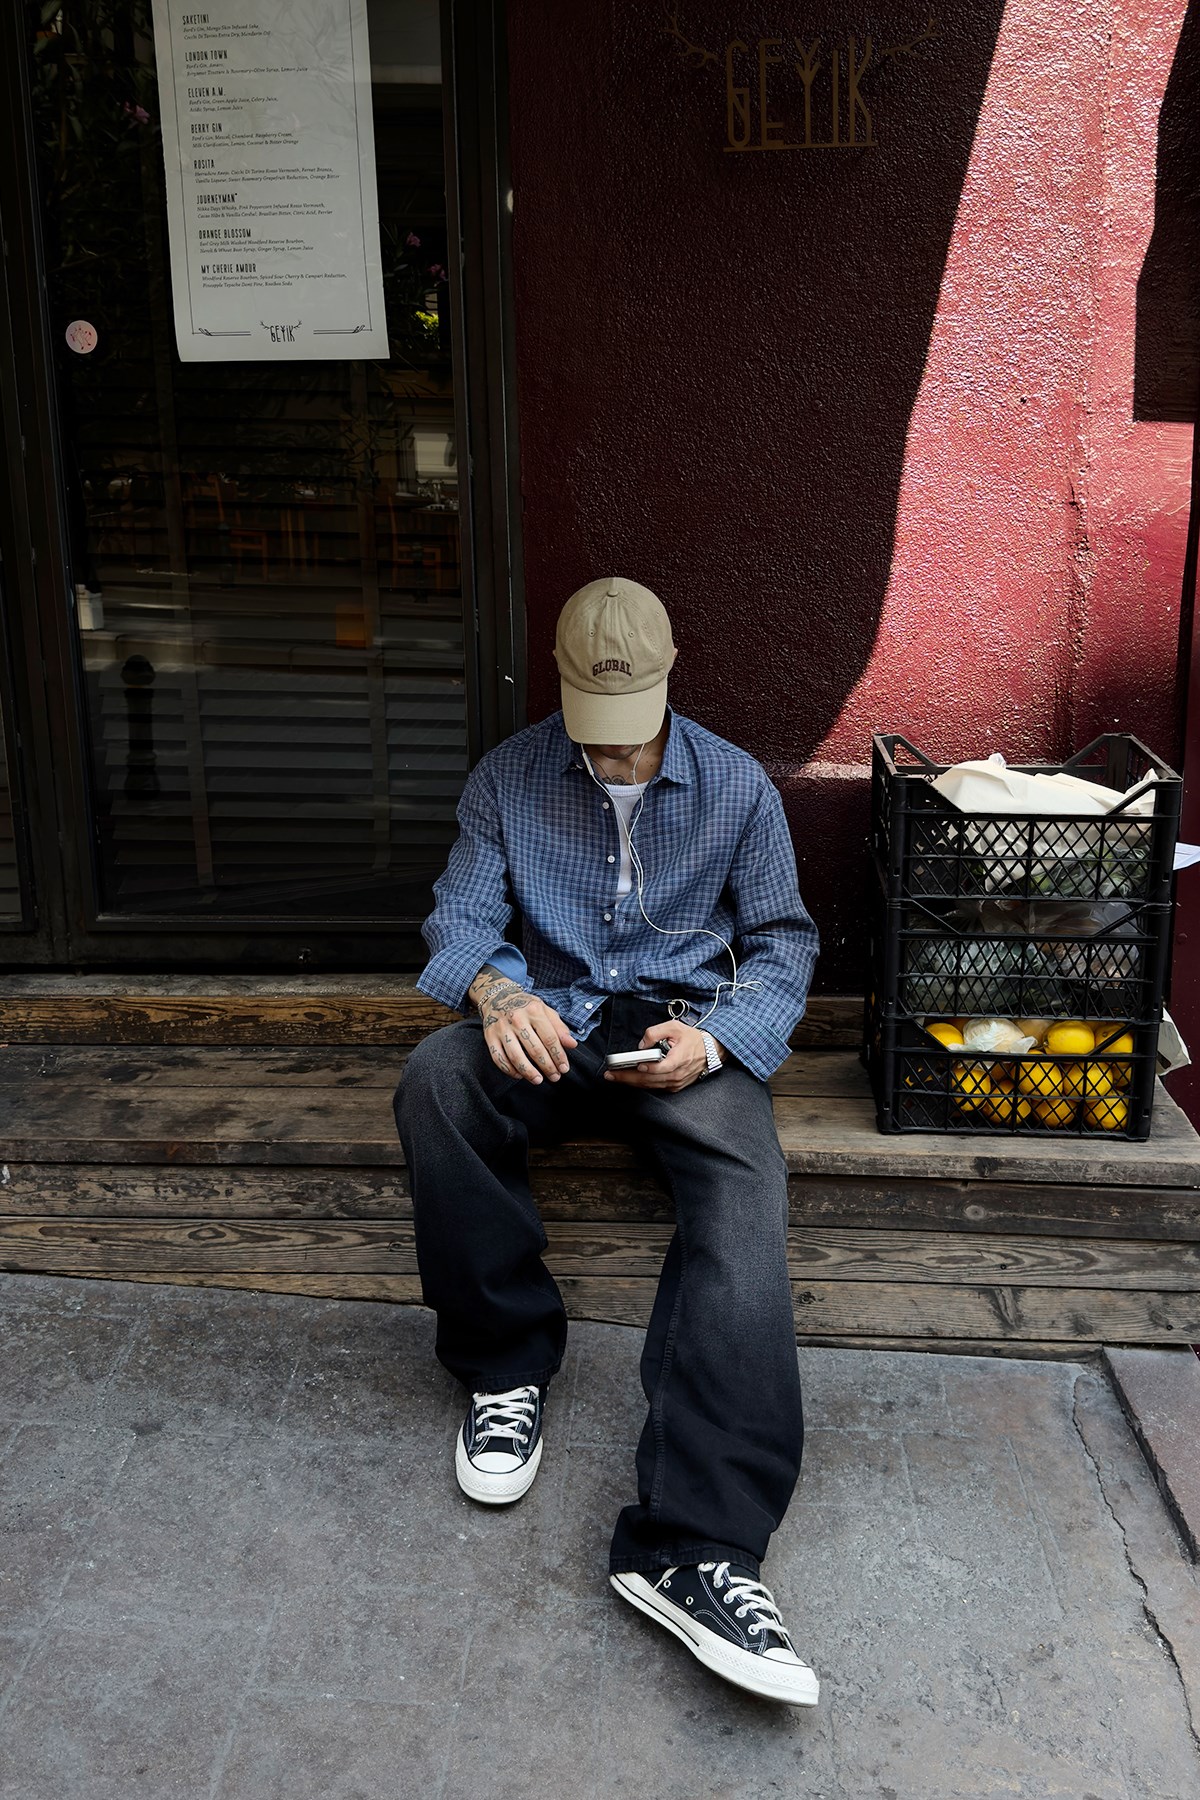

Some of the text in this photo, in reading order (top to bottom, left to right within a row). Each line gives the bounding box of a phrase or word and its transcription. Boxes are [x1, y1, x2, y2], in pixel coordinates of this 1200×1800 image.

[182, 14, 209, 25] SAKETINI
[185, 50, 228, 62] LONDON TOWN
[188, 87, 226, 98] ELEVEN A.M.
[191, 123, 223, 134] BERRY GIN
[194, 159, 215, 169] ROSITA
[199, 228, 251, 239] ORANGE BLOSSOM
[201, 263, 257, 274] MY CHERIE AMOUR
[592, 659, 632, 677] GLOBAL
